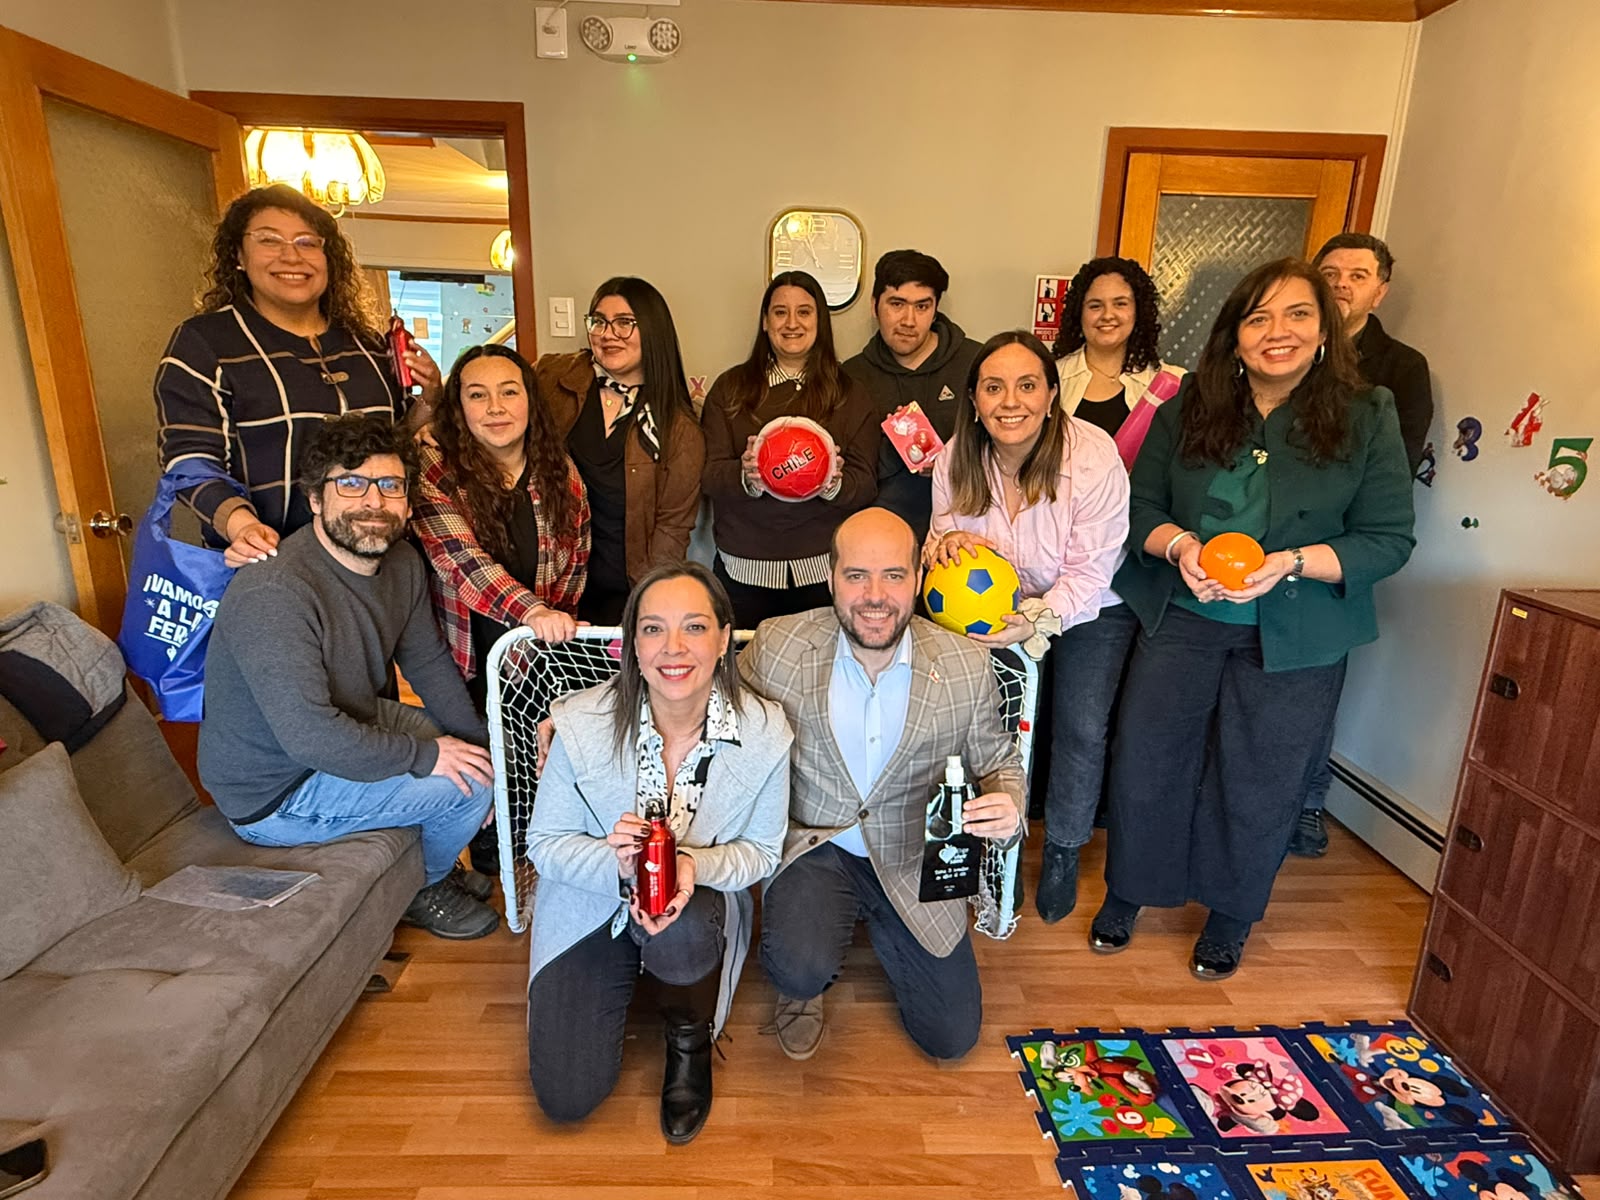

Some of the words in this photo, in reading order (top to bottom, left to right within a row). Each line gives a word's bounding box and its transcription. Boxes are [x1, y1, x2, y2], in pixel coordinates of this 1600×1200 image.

[1454, 416, 1483, 462] 3
[771, 447, 816, 480] CHILE
[1548, 437, 1594, 497] 5
[156, 598, 171, 618] A
